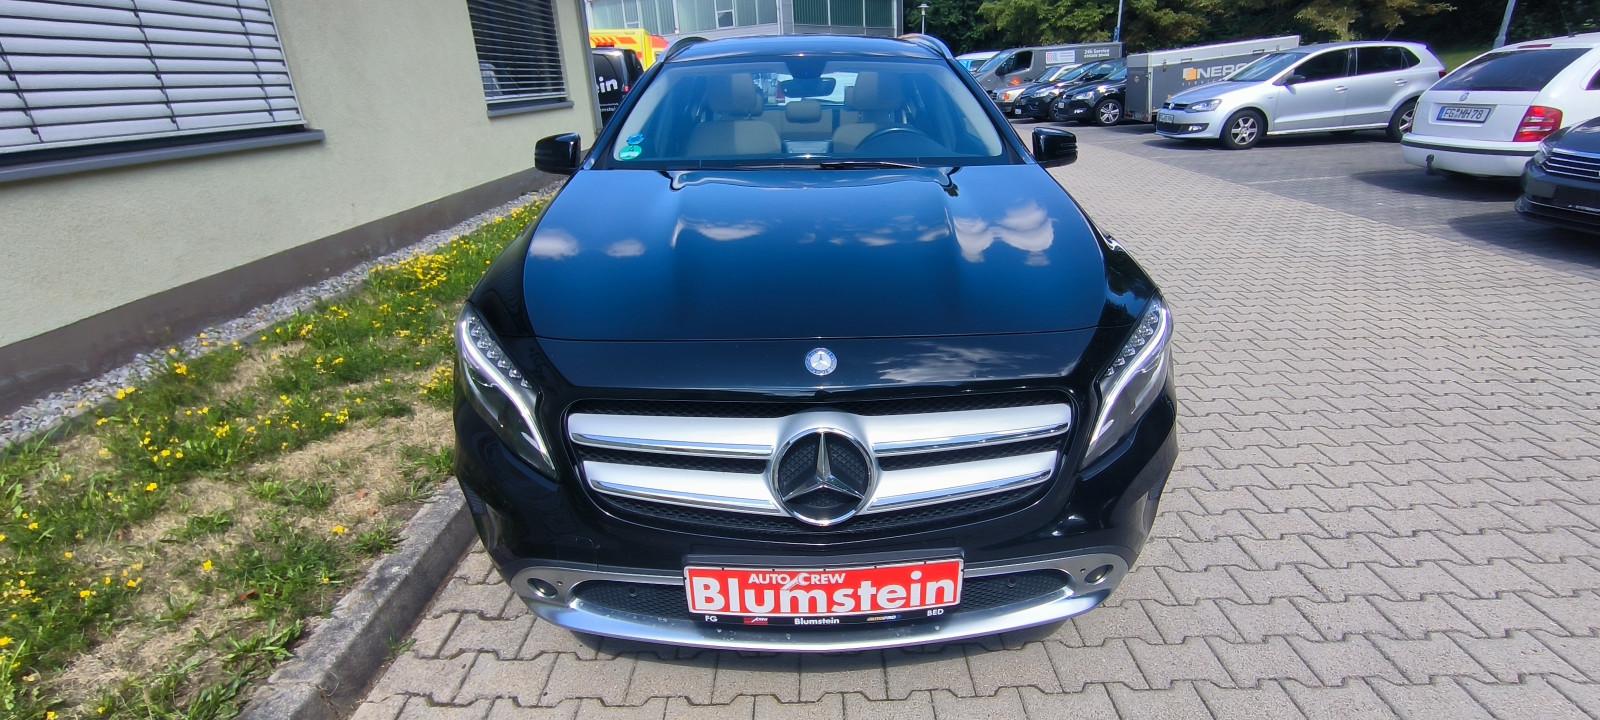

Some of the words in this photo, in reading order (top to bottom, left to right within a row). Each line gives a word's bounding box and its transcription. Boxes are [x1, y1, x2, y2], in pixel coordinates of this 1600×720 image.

[597, 76, 618, 93] in
[748, 573, 790, 584] AUTO
[797, 572, 846, 586] CREW
[692, 570, 955, 613] Blumstein
[705, 615, 718, 623] FG
[794, 617, 840, 625] Blumstein
